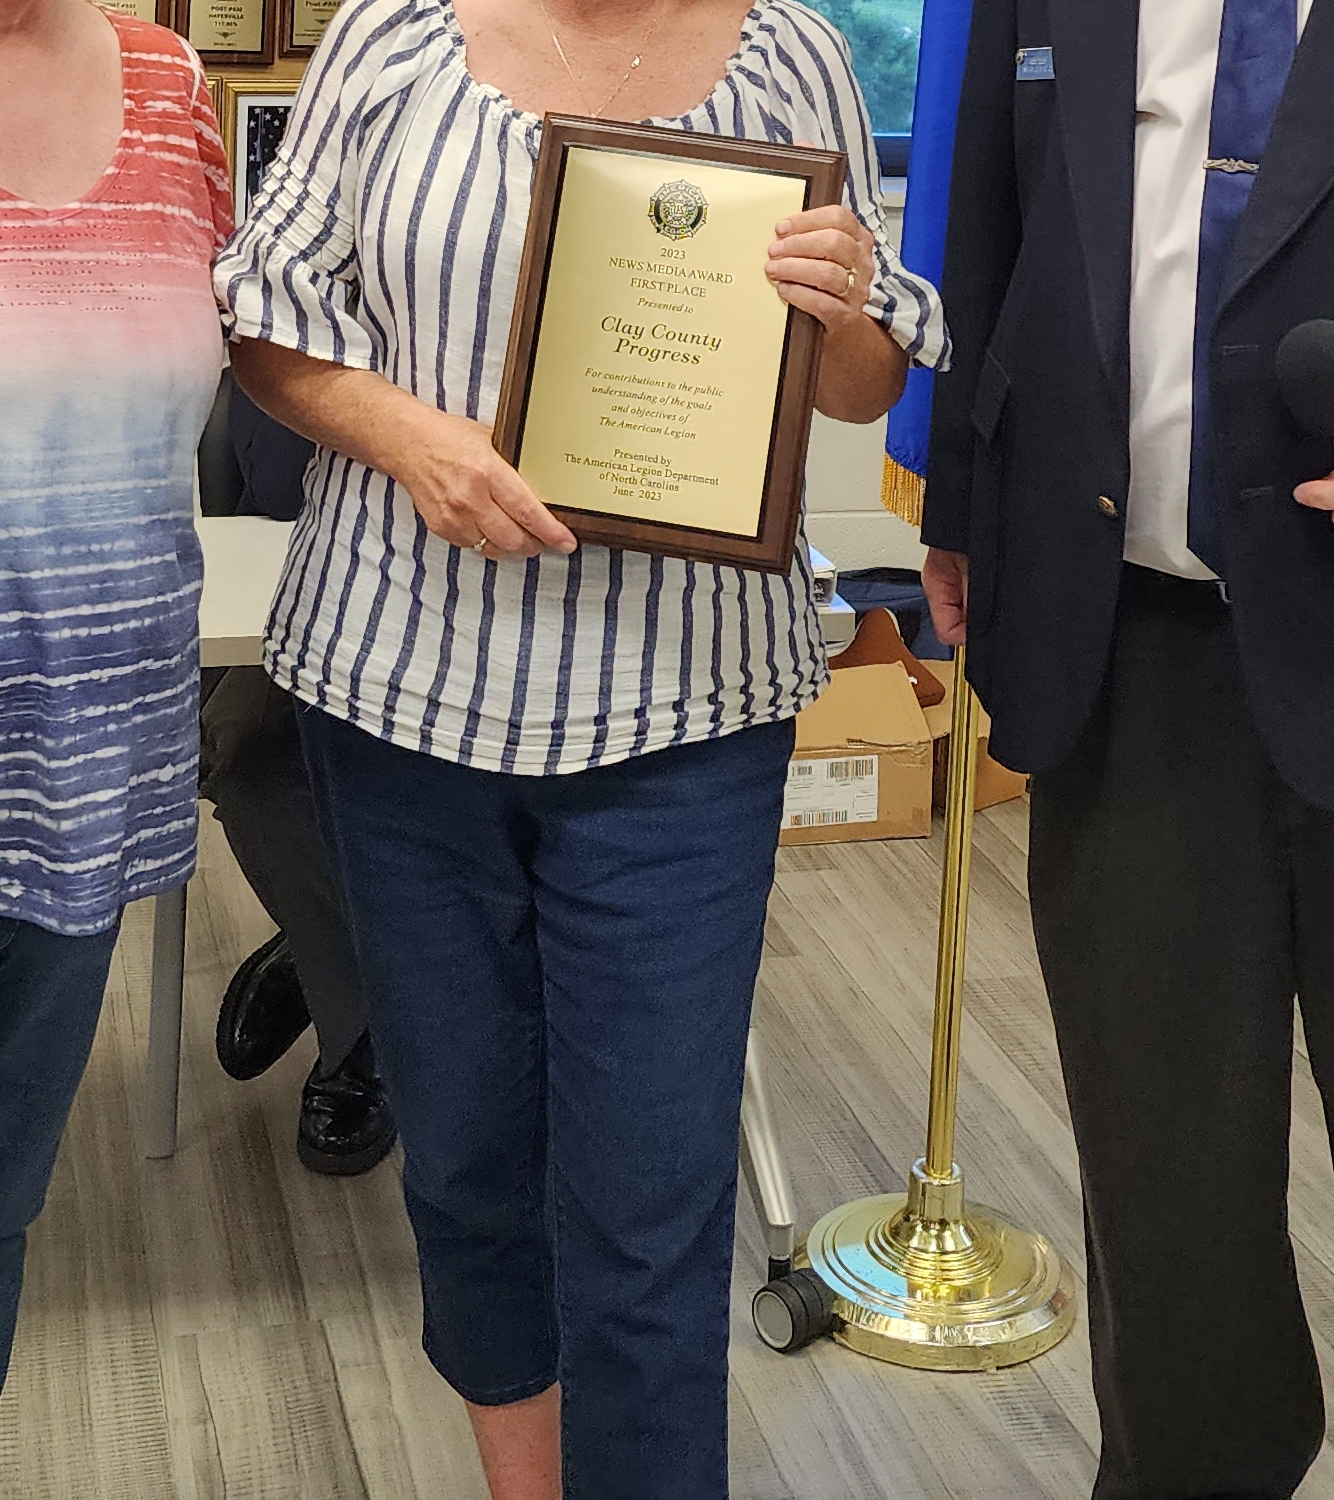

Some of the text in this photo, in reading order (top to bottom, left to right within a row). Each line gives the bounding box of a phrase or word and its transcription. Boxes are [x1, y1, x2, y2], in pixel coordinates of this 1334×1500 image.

[660, 247, 686, 260] 2023
[609, 257, 733, 284] NEWS MEDIA AWARD
[630, 277, 707, 298] FIRST PLACE
[637, 297, 694, 314] Presented to
[601, 315, 722, 352] Clay County
[612, 337, 701, 365] Progress
[584, 367, 724, 397] For contributions to the public
[591, 385, 713, 411] understanding of the goals
[611, 404, 691, 425] and objectives of
[599, 416, 697, 440] The American Legion
[614, 448, 672, 467] Presented by
[564, 453, 720, 486] The American Legion Department
[599, 471, 680, 492] of North Carolina
[612, 485, 662, 501] June 2023
